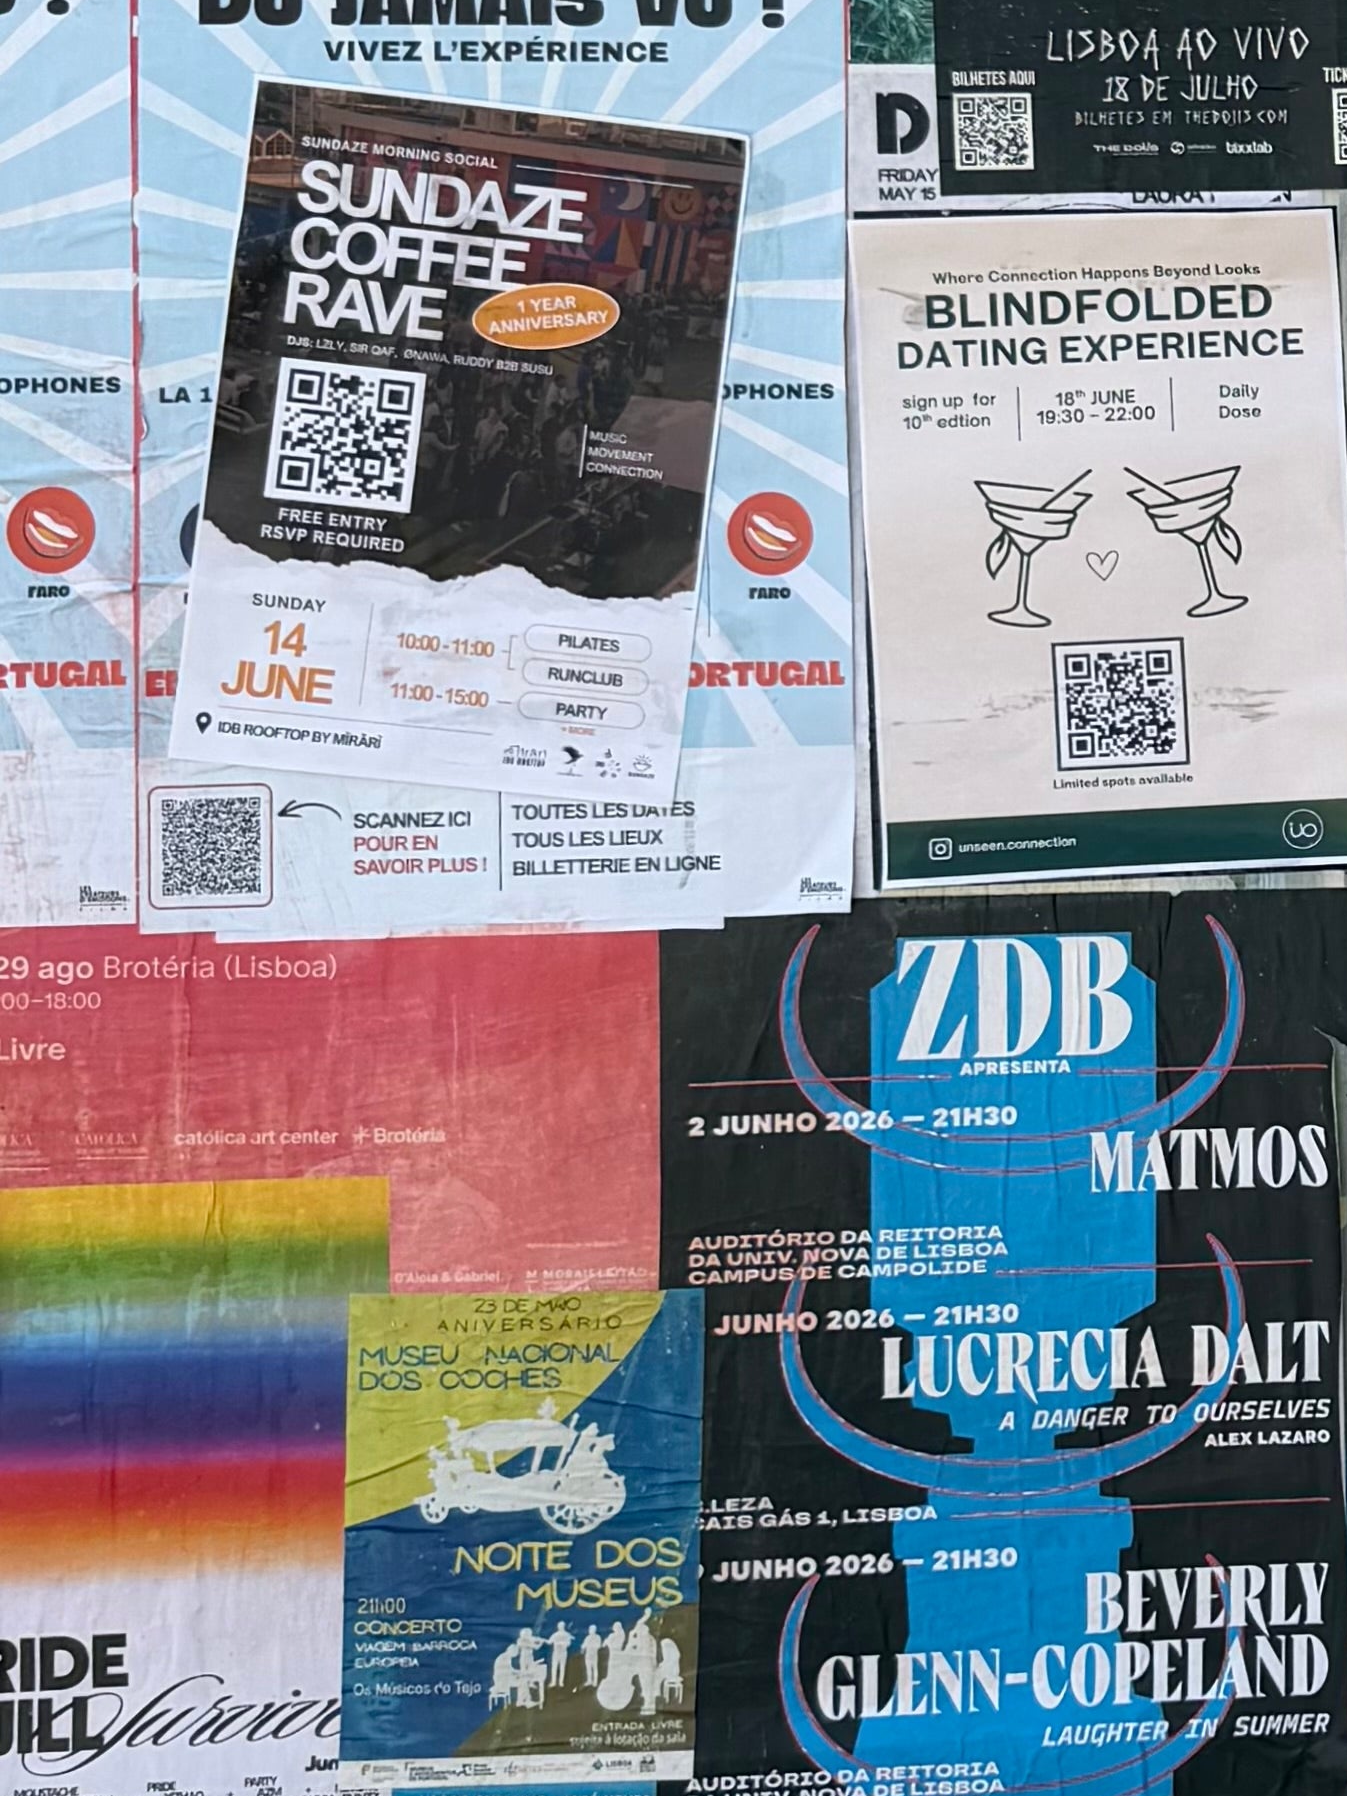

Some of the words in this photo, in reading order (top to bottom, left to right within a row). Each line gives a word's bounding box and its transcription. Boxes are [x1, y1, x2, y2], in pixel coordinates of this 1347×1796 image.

[1046, 28, 1161, 71] LISBOA
[1178, 27, 1217, 70] AO
[1234, 26, 1310, 60] VIVO
[952, 70, 1004, 87] BILHETES
[1006, 70, 1035, 87] AQUI
[1102, 76, 1129, 101] 18
[1141, 75, 1170, 101] DE
[1178, 74, 1258, 101] JULHO
[301, 135, 369, 155] SUNDAZE
[372, 142, 441, 163] MORNING
[444, 152, 498, 169] SOCIAL
[878, 169, 938, 183] FRIDAY
[298, 160, 588, 243] SUNDAZE
[879, 187, 915, 200] MAY
[920, 187, 936, 200] 15
[290, 217, 531, 291] COFFEE
[932, 270, 984, 285] Where
[988, 268, 1078, 283] Connection
[1081, 266, 1149, 283] Happens
[1153, 264, 1211, 281] Beyond
[1214, 263, 1261, 277] Looks
[282, 271, 448, 341] RAVE
[516, 299, 526, 312] 1
[530, 295, 577, 311] YEAR
[924, 284, 1273, 330] BLINDFOLDED
[488, 309, 609, 335] ANNIVERSARY
[898, 337, 1048, 369] DATING
[1060, 328, 1305, 363] EXPERIENCE
[902, 392, 939, 412] sign
[943, 395, 963, 411] up
[972, 391, 997, 407] for
[1056, 388, 1086, 407] 18th
[1090, 388, 1136, 405] JUNE
[1219, 383, 1259, 402] Daily
[937, 412, 991, 428] edtion
[1036, 408, 1085, 425] 19:30
[1104, 405, 1156, 423] 22:00
[1218, 404, 1262, 419] Dose
[278, 507, 324, 527] FREE
[328, 512, 388, 532] ENTRY
[260, 523, 309, 542] RSVP
[312, 528, 405, 554] REQUIRED
[251, 593, 326, 614] SUNDAY
[263, 620, 307, 658] 14
[558, 633, 621, 653] PILATES
[220, 660, 336, 706] JUNE
[548, 666, 623, 688] RUNCLUB
[688, 661, 845, 688] ORTUGAL
[555, 701, 608, 721] PARTY
[1053, 775, 1099, 790] Limited
[1102, 775, 1137, 791] spots
[1139, 772, 1194, 786] available
[959, 836, 1077, 854] unseen.connection
[512, 858, 630, 876] BILLETTERIE
[635, 857, 661, 872] EN
[665, 855, 721, 872] LIGNE
[0, 956, 29, 980] 29
[38, 961, 94, 985] ago
[103, 953, 215, 979] Brotéria
[224, 954, 338, 981] (Lisboa)
[897, 935, 1133, 1062] ZDB
[959, 1060, 1071, 1076] APRESENTA
[688, 1118, 705, 1138] 2
[712, 1113, 817, 1137] JUNHO
[824, 1109, 893, 1132] 2026
[932, 1106, 1018, 1128] 21H30
[1090, 1124, 1329, 1194] MATMOS
[688, 1229, 834, 1251] AUDITÓRIO
[840, 1226, 873, 1245] DA
[878, 1224, 1003, 1243] REITORIA
[437, 1315, 622, 1333] ANIVERSÁRIO
[358, 1345, 460, 1367] MUSEU
[485, 1342, 622, 1364] NACIONAL
[881, 1325, 1168, 1403] LUCRECIA
[1190, 1320, 1331, 1388] DALT
[358, 1370, 422, 1391] DOS
[439, 1368, 562, 1390] COCHES
[998, 1410, 1015, 1432] A
[1031, 1406, 1129, 1431] DANGER
[1147, 1404, 1176, 1425] TO
[1192, 1399, 1331, 1424] OURSELVES
[1205, 1431, 1255, 1448] ALEX
[1258, 1429, 1331, 1447] LAZARO
[454, 1541, 574, 1575] NOITE
[596, 1538, 685, 1569] DOS
[516, 1576, 685, 1611] MUSEUS
[1084, 1562, 1329, 1636] BEVERLY
[353, 1619, 462, 1635] CONCERTO
[816, 1631, 1331, 1723] GLENN-COPELAND
[1041, 1721, 1171, 1747] LAUGHTER
[1185, 1717, 1218, 1739] IN
[1233, 1712, 1331, 1737] SUMMER
